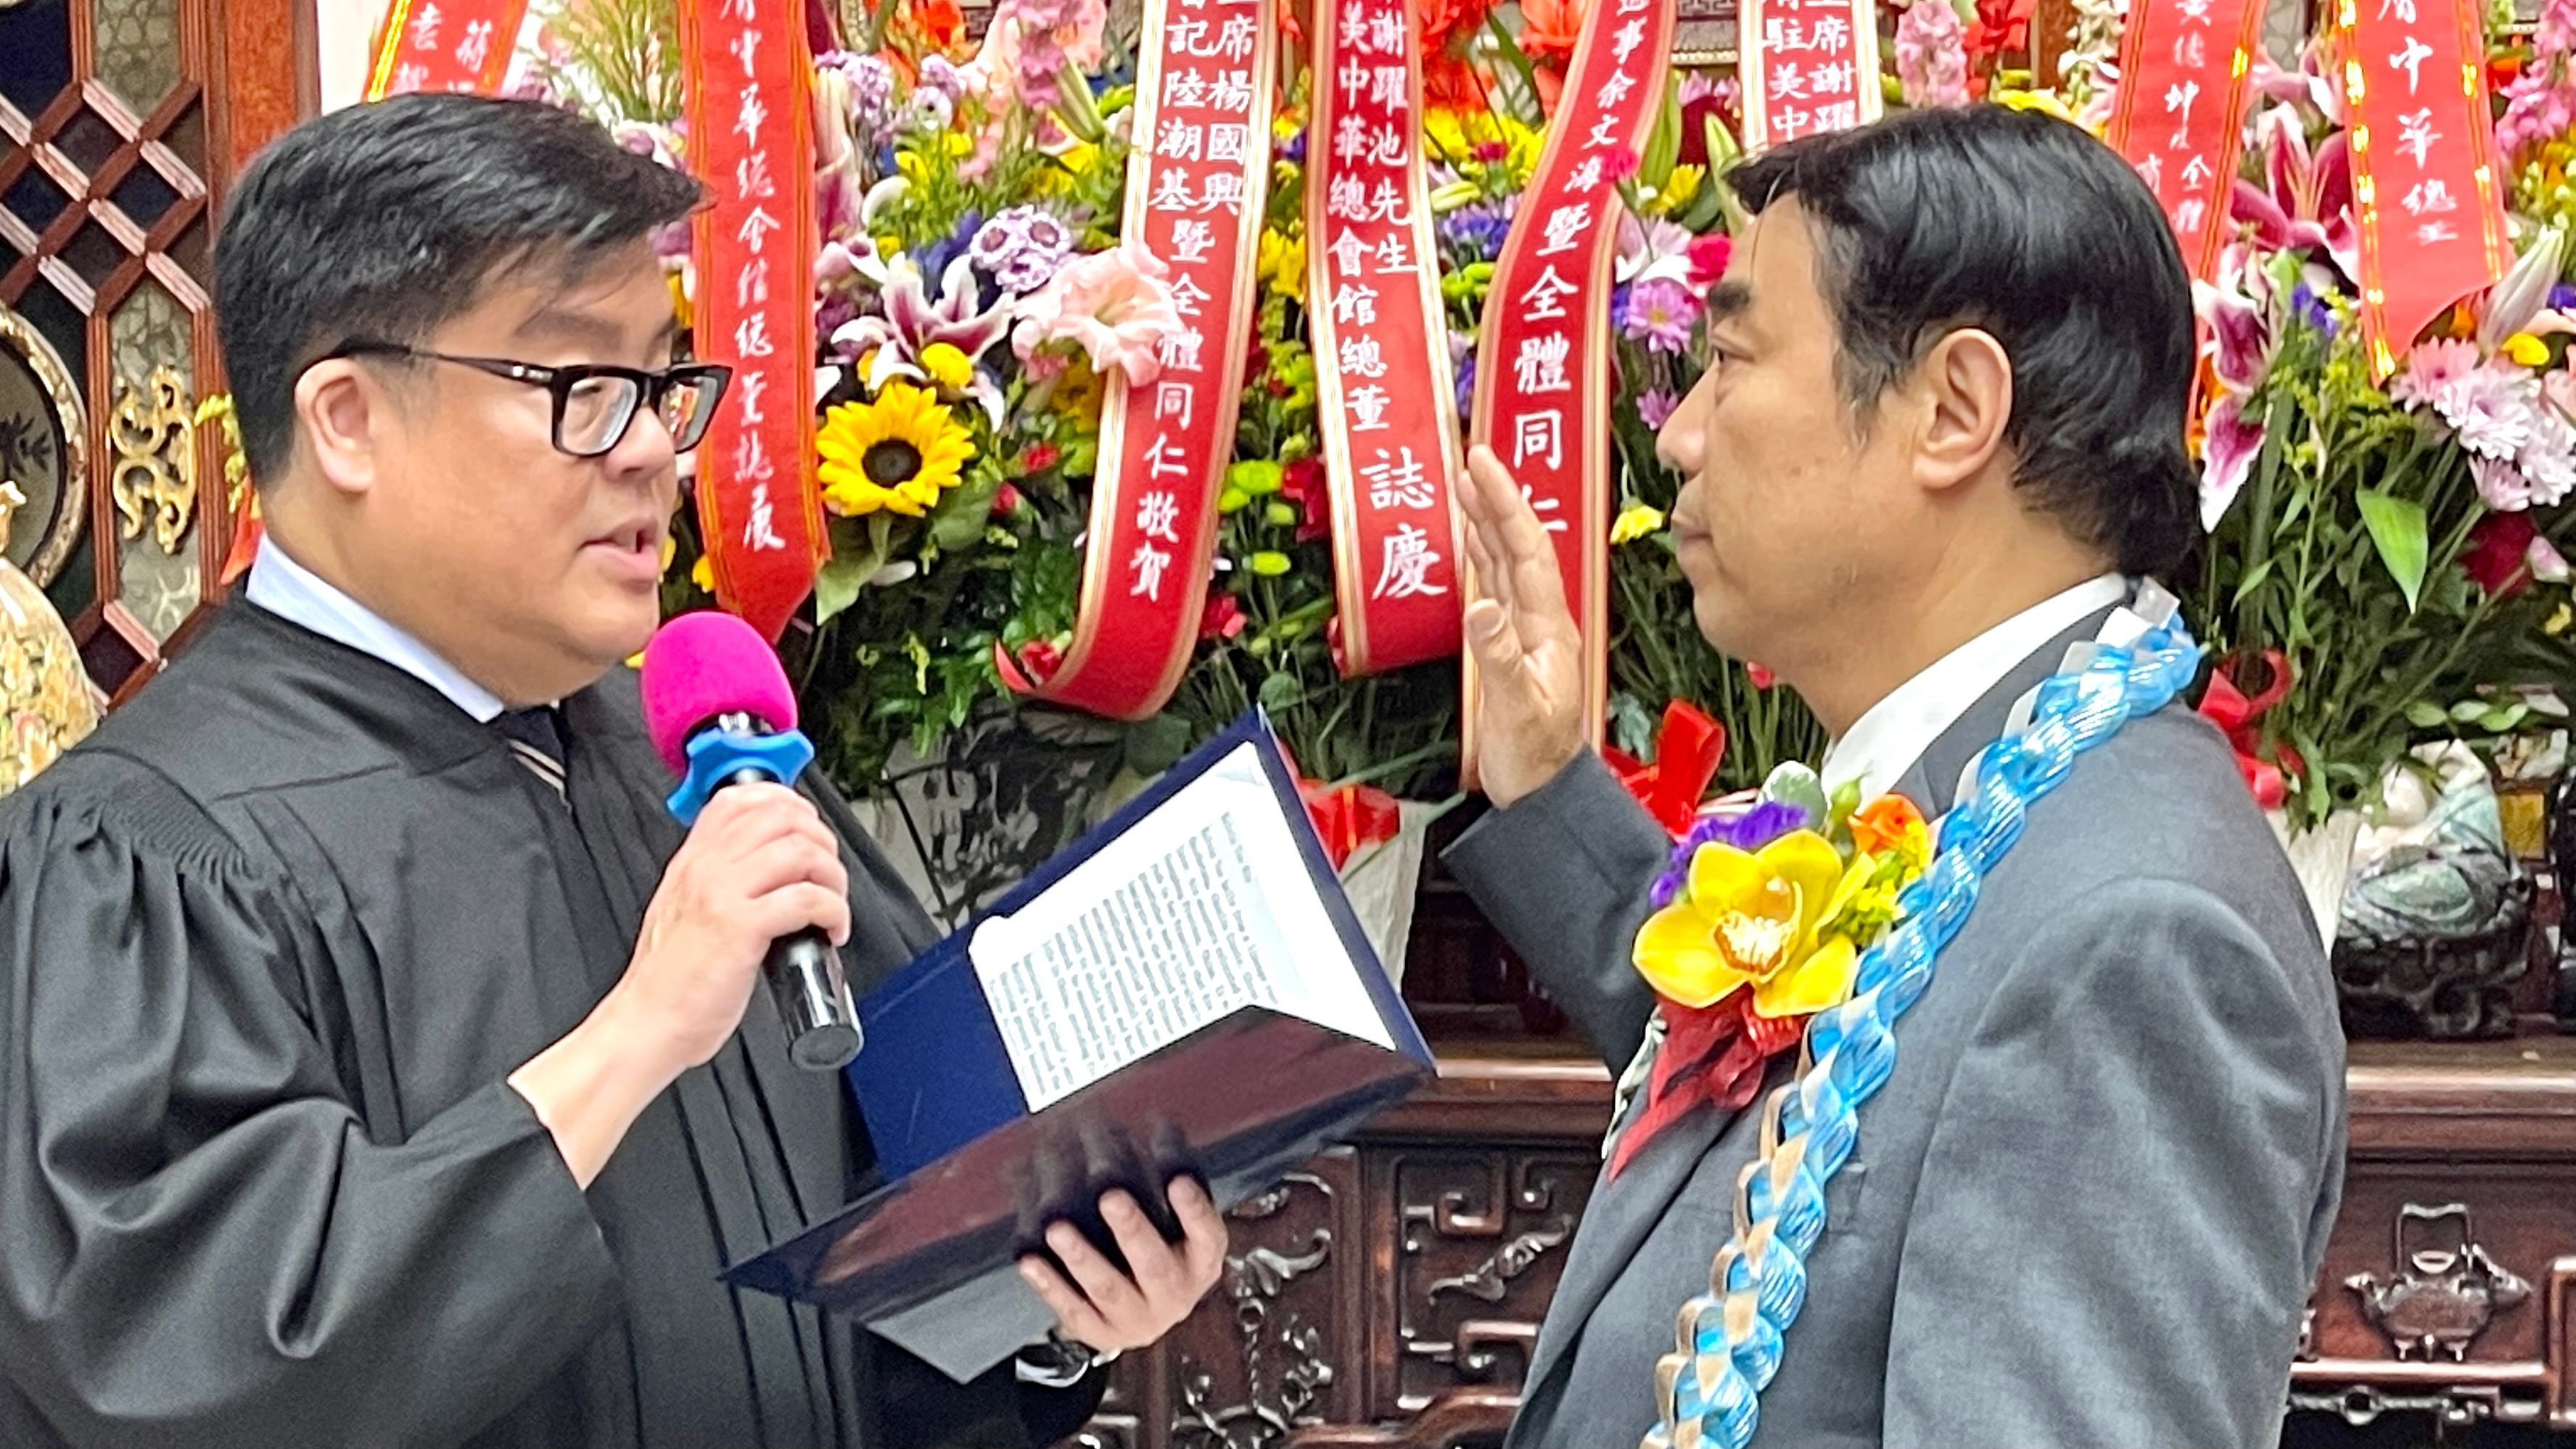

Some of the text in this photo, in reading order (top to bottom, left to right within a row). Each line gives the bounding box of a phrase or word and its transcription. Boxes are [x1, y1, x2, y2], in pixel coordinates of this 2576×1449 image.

[1197, 0, 1259, 215] 席楊國興
[1367, 8, 1417, 274] 謝躍池先生
[1762, 0, 1811, 141] 駐美中
[1805, 0, 1857, 133] 席謝躍
[1327, 1, 1391, 432] 美中華總會館總董
[1129, 218, 1215, 602] 暨全體同仁敬賀
[1360, 445, 1448, 601] 誌慶
